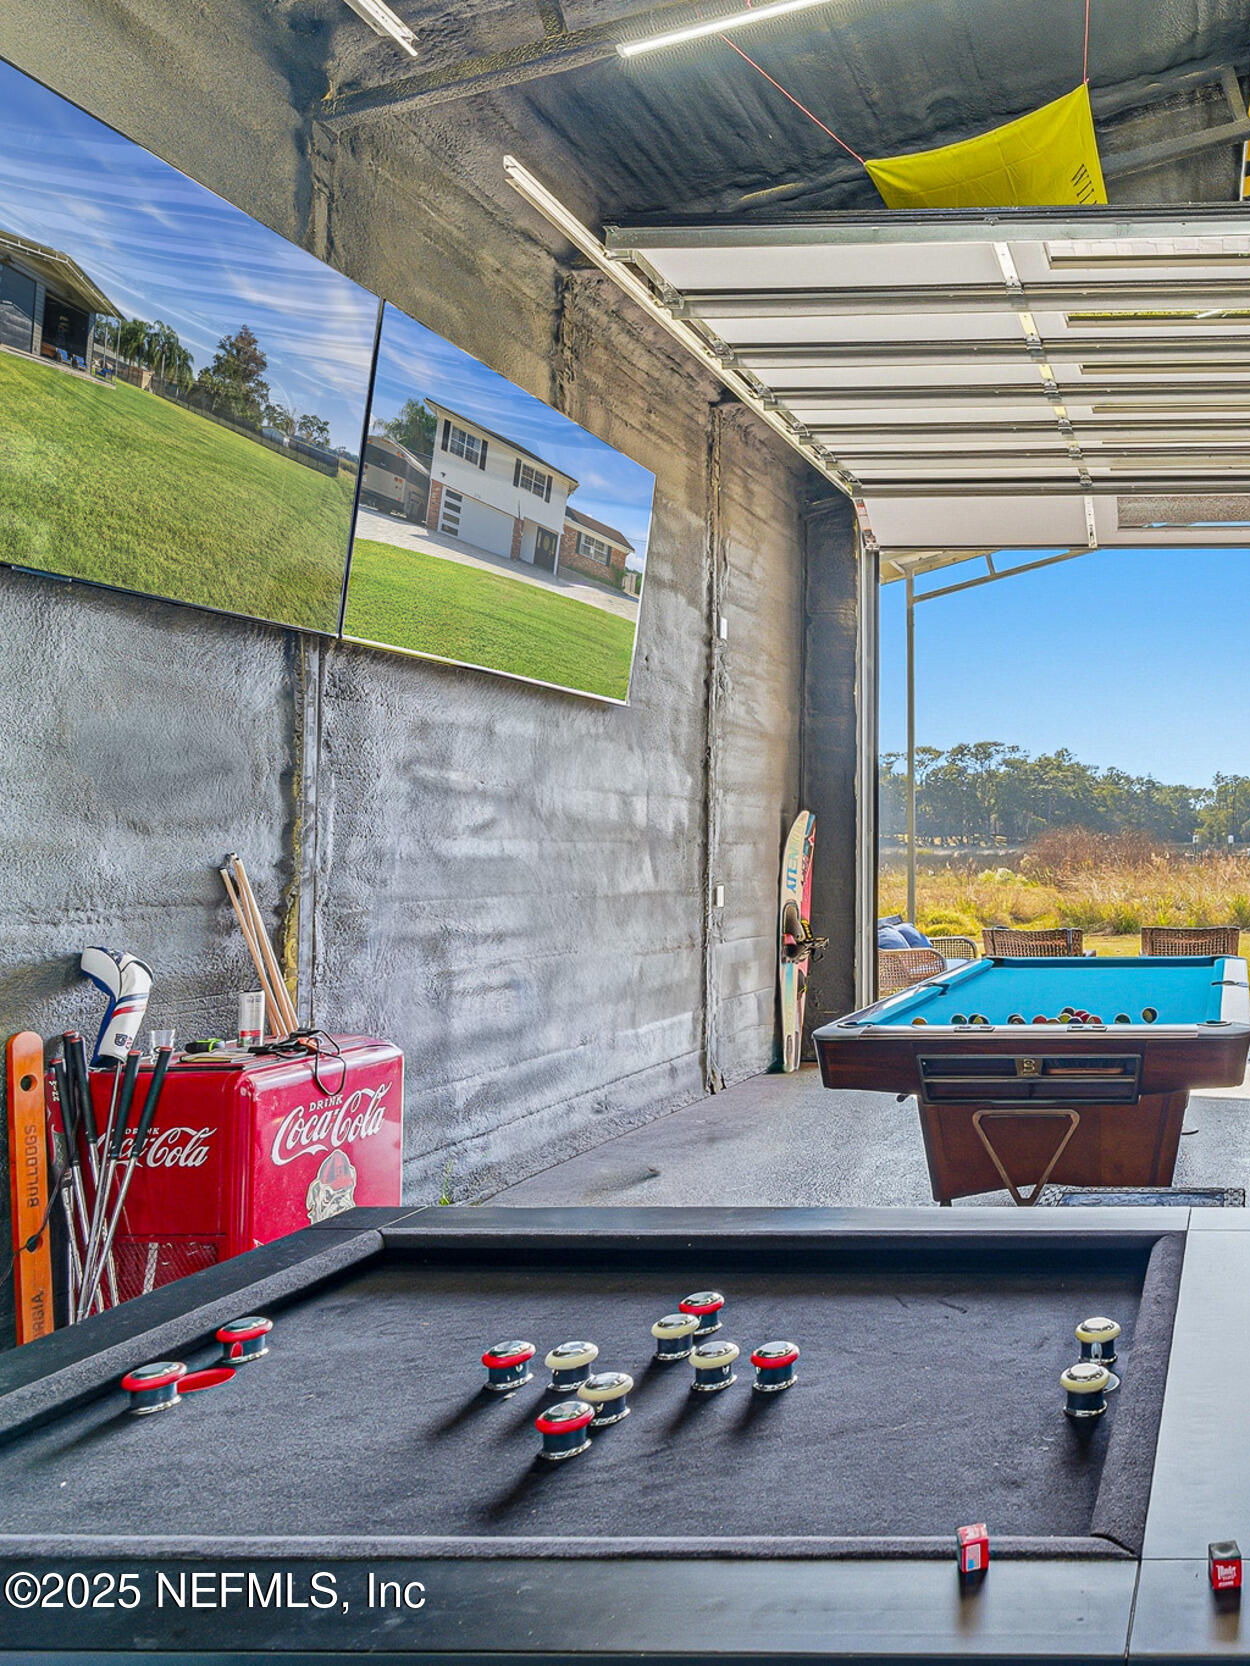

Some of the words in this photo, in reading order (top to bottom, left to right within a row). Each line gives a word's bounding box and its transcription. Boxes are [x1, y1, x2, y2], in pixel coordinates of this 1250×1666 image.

[271, 1081, 393, 1166] Coca-Cola
[309, 1094, 344, 1112] DRINK
[24, 1125, 40, 1208] BULLDOGS
